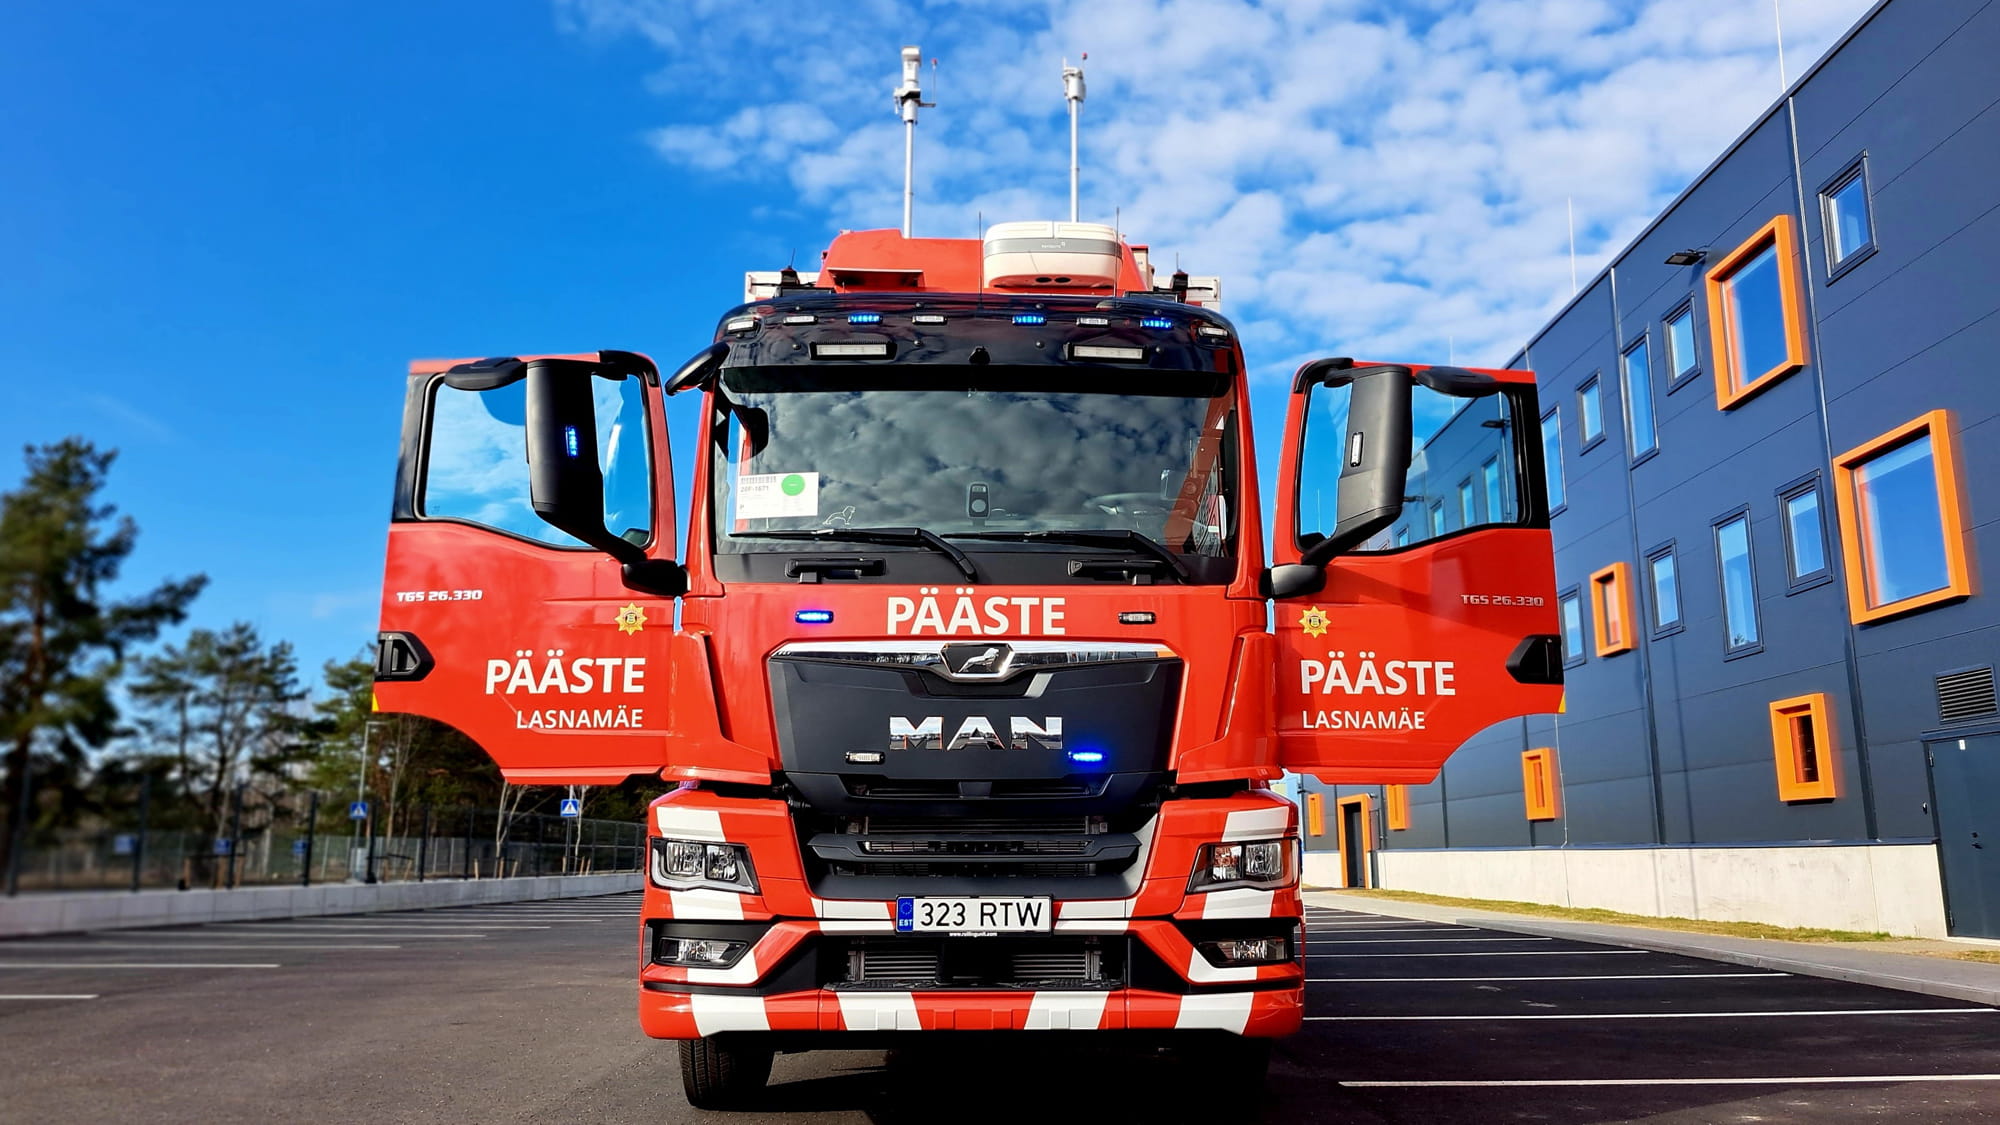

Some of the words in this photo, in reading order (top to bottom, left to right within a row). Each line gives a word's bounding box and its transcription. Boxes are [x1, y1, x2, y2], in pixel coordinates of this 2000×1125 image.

[396, 592, 425, 602] TGS
[428, 590, 483, 601] 26.330
[1460, 594, 1489, 605] TGS
[1492, 595, 1544, 606] 26.330
[887, 587, 1065, 635] PÄÄSTE
[485, 649, 646, 695] PÄÄSTE
[1300, 651, 1456, 696] PÄÄSTE
[516, 705, 643, 729] LASNAMÄE
[1302, 707, 1425, 730] LASNAMÄE
[889, 716, 1063, 750] MAN
[920, 902, 966, 927] 323
[980, 902, 1042, 927] RTW
